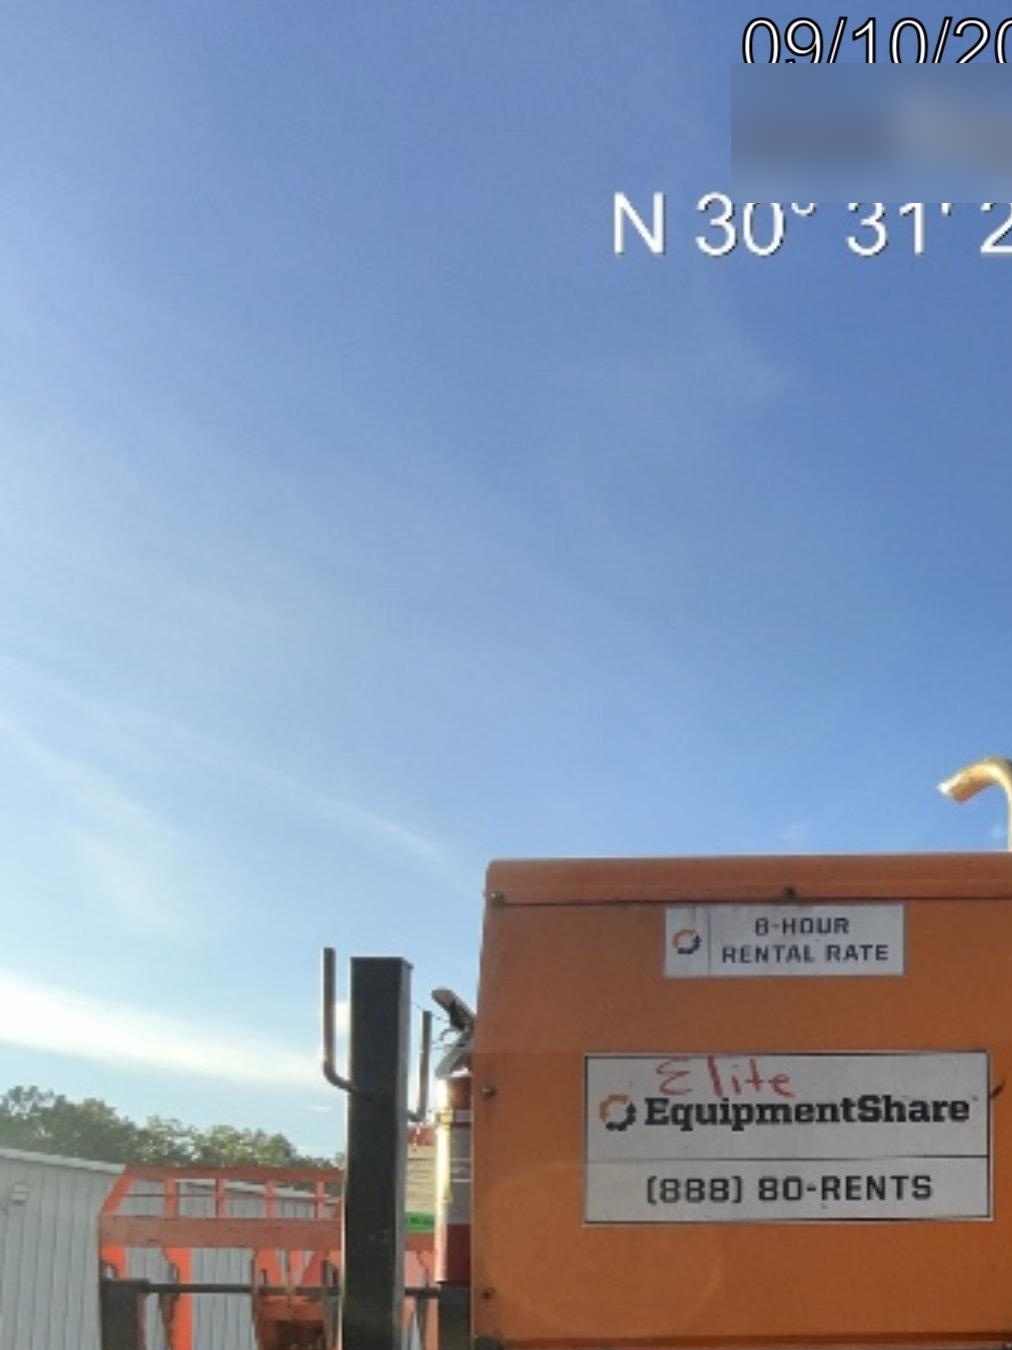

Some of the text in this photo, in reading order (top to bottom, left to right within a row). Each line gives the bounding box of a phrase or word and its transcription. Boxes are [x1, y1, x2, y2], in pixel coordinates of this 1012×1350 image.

[754, 916, 850, 937] 8-HOUR
[721, 943, 890, 964] RENTAL RATE
[655, 1055, 795, 1099] Elite
[643, 1094, 972, 1132] EquipmentShare
[646, 1174, 934, 1206] (888) 80-RENTS
